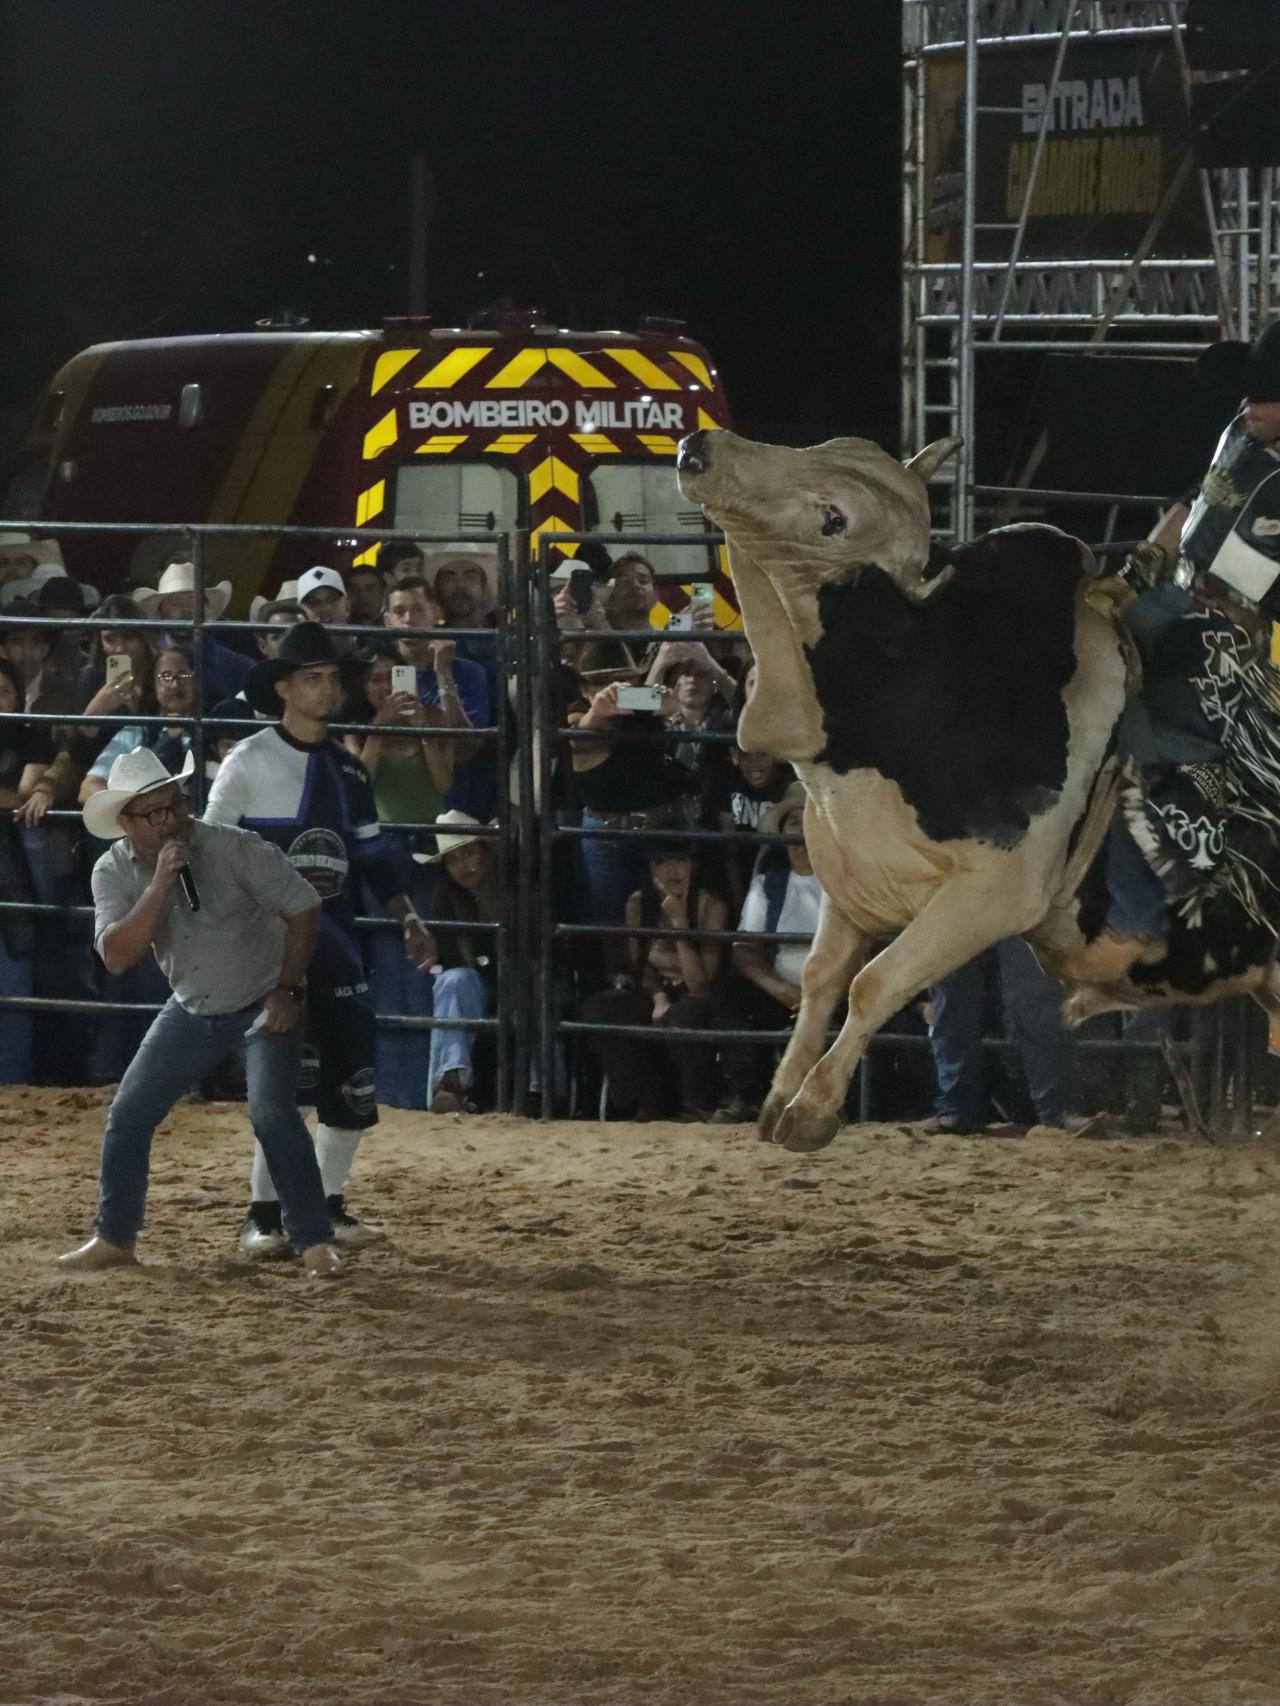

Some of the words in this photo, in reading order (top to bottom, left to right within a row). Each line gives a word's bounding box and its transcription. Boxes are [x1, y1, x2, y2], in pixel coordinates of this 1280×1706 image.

[1022, 76, 1144, 133] ENTRADA
[409, 401, 569, 429] BOMBEIRO
[575, 401, 685, 430] MILITAR
